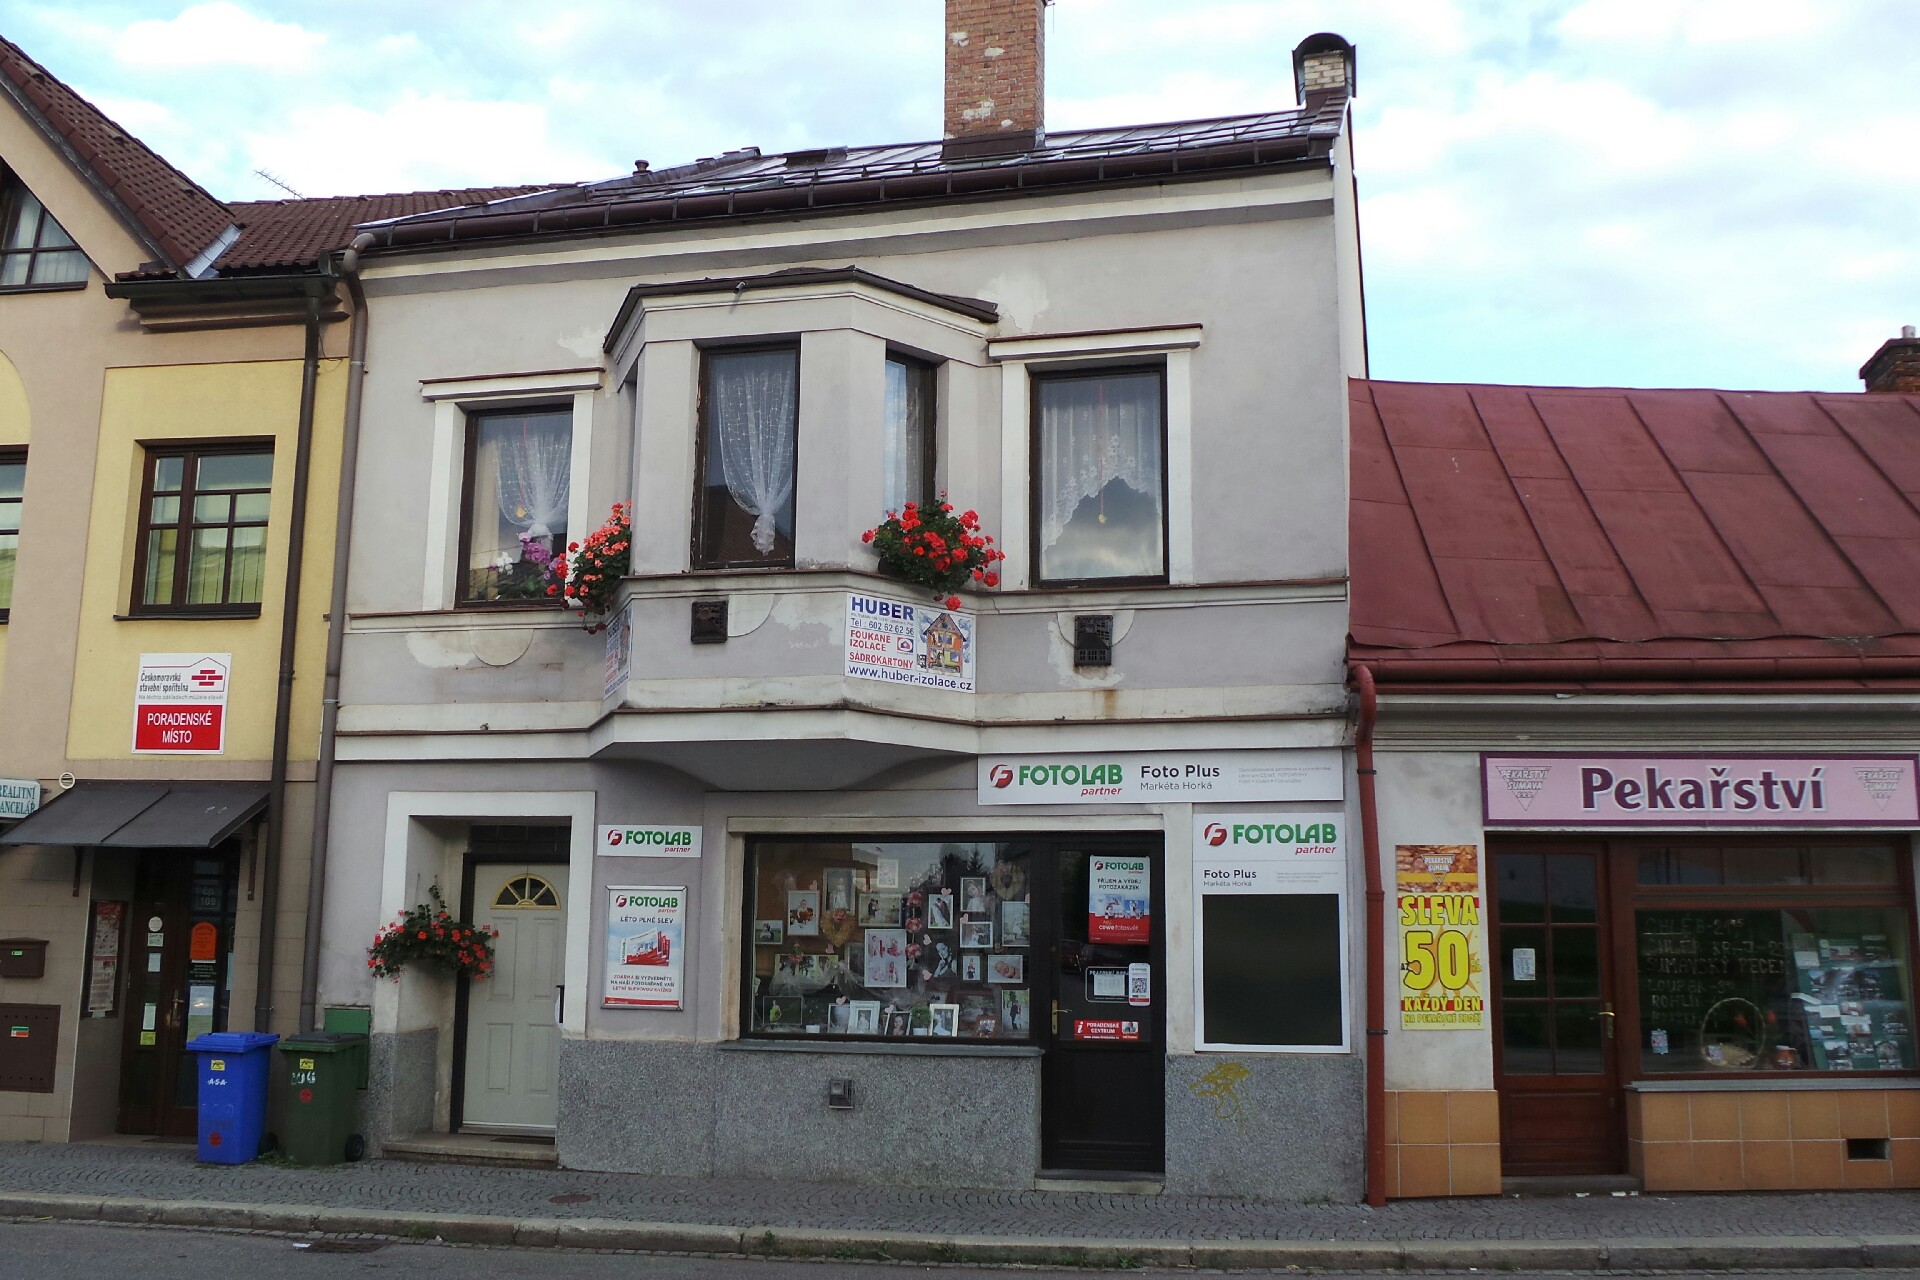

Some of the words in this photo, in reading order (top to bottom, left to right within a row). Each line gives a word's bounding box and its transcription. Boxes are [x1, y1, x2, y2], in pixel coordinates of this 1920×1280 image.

[851, 597, 914, 621] HUBER
[868, 620, 882, 630] 602
[850, 629, 891, 643] FOUKANÉ
[849, 639, 886, 652] IZOLACE
[849, 651, 914, 669] SÁDROKARTONY
[141, 670, 182, 682] Českomoravská
[848, 665, 973, 691] www.huber-izolace.cz
[139, 683, 162, 692] stavební
[162, 683, 189, 694] spořitelna
[147, 709, 212, 726] PORADENSKÉ
[162, 727, 192, 743] MÍSTO
[1019, 764, 1123, 786] FOTOLAB
[1140, 765, 1179, 778] Foto
[1185, 764, 1220, 778] Plus
[1501, 767, 1549, 779] PEKAŘSTVÍ
[1081, 786, 1122, 797] partner
[1140, 781, 1180, 791] Markéta
[1182, 781, 1213, 790] Horká
[1580, 766, 1825, 810] Pekařství
[0, 800, 36, 814] ANCELÁŘ
[625, 830, 692, 846] FOTOLAB
[1232, 823, 1337, 844] FOTOLAB
[1295, 845, 1337, 855] partner
[1105, 862, 1144, 870] FOTOLAB
[1203, 869, 1230, 879] Foto
[1233, 869, 1257, 879] Plus
[629, 896, 678, 908] FOTOLAB
[1401, 895, 1479, 926] SLEVA
[620, 915, 637, 923] LÉTO
[639, 916, 656, 924] PLNÉ
[1403, 930, 1469, 990] 50
[1404, 993, 1448, 1012] KAŽDÝ
[1453, 995, 1481, 1012] DEN
[1404, 1013, 1415, 1023] NA
